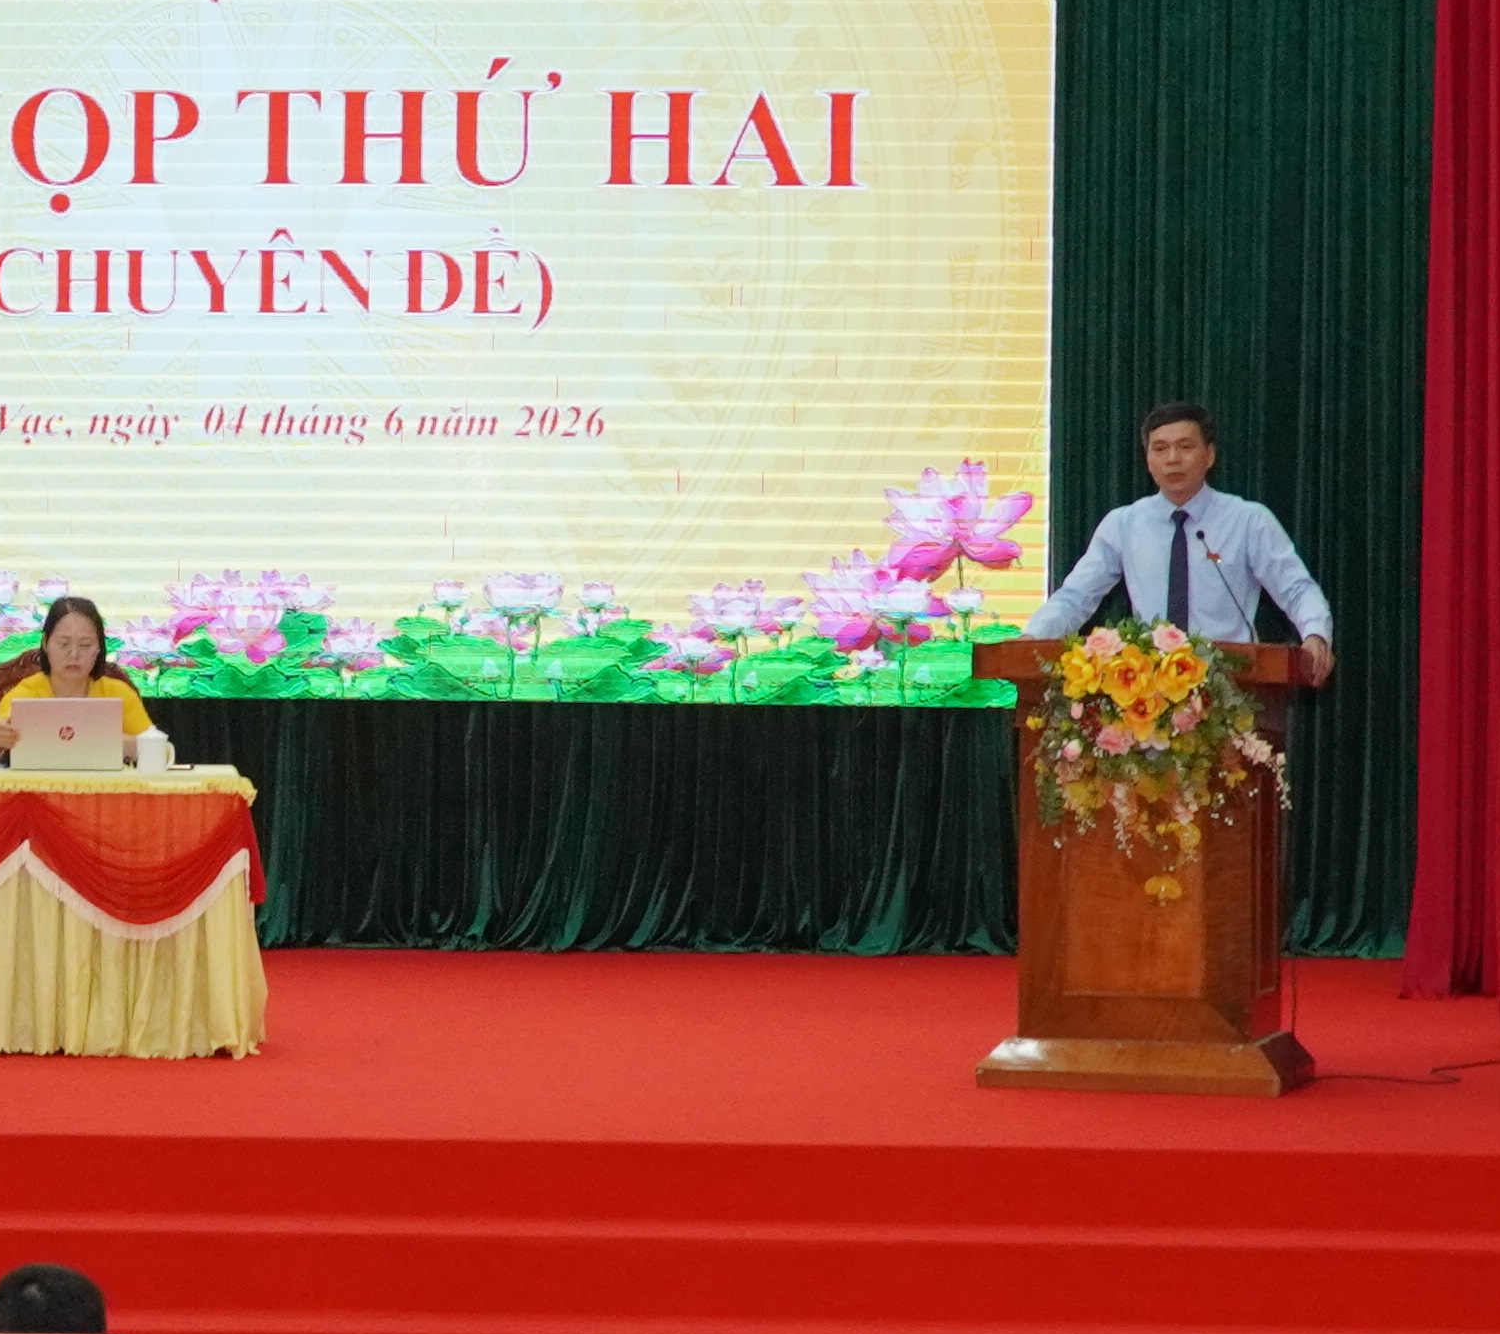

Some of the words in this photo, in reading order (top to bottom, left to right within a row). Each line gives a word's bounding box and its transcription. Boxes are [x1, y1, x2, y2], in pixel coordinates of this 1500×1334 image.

[234, 53, 565, 189] THỨ
[599, 87, 869, 189] HAI
[400, 225, 556, 332] ĐỀ)
[88, 403, 181, 446] ngày
[202, 401, 246, 437] 04
[260, 401, 372, 446] tháng
[383, 401, 404, 436] 6
[416, 402, 501, 437] năm
[512, 402, 607, 438] 2026
